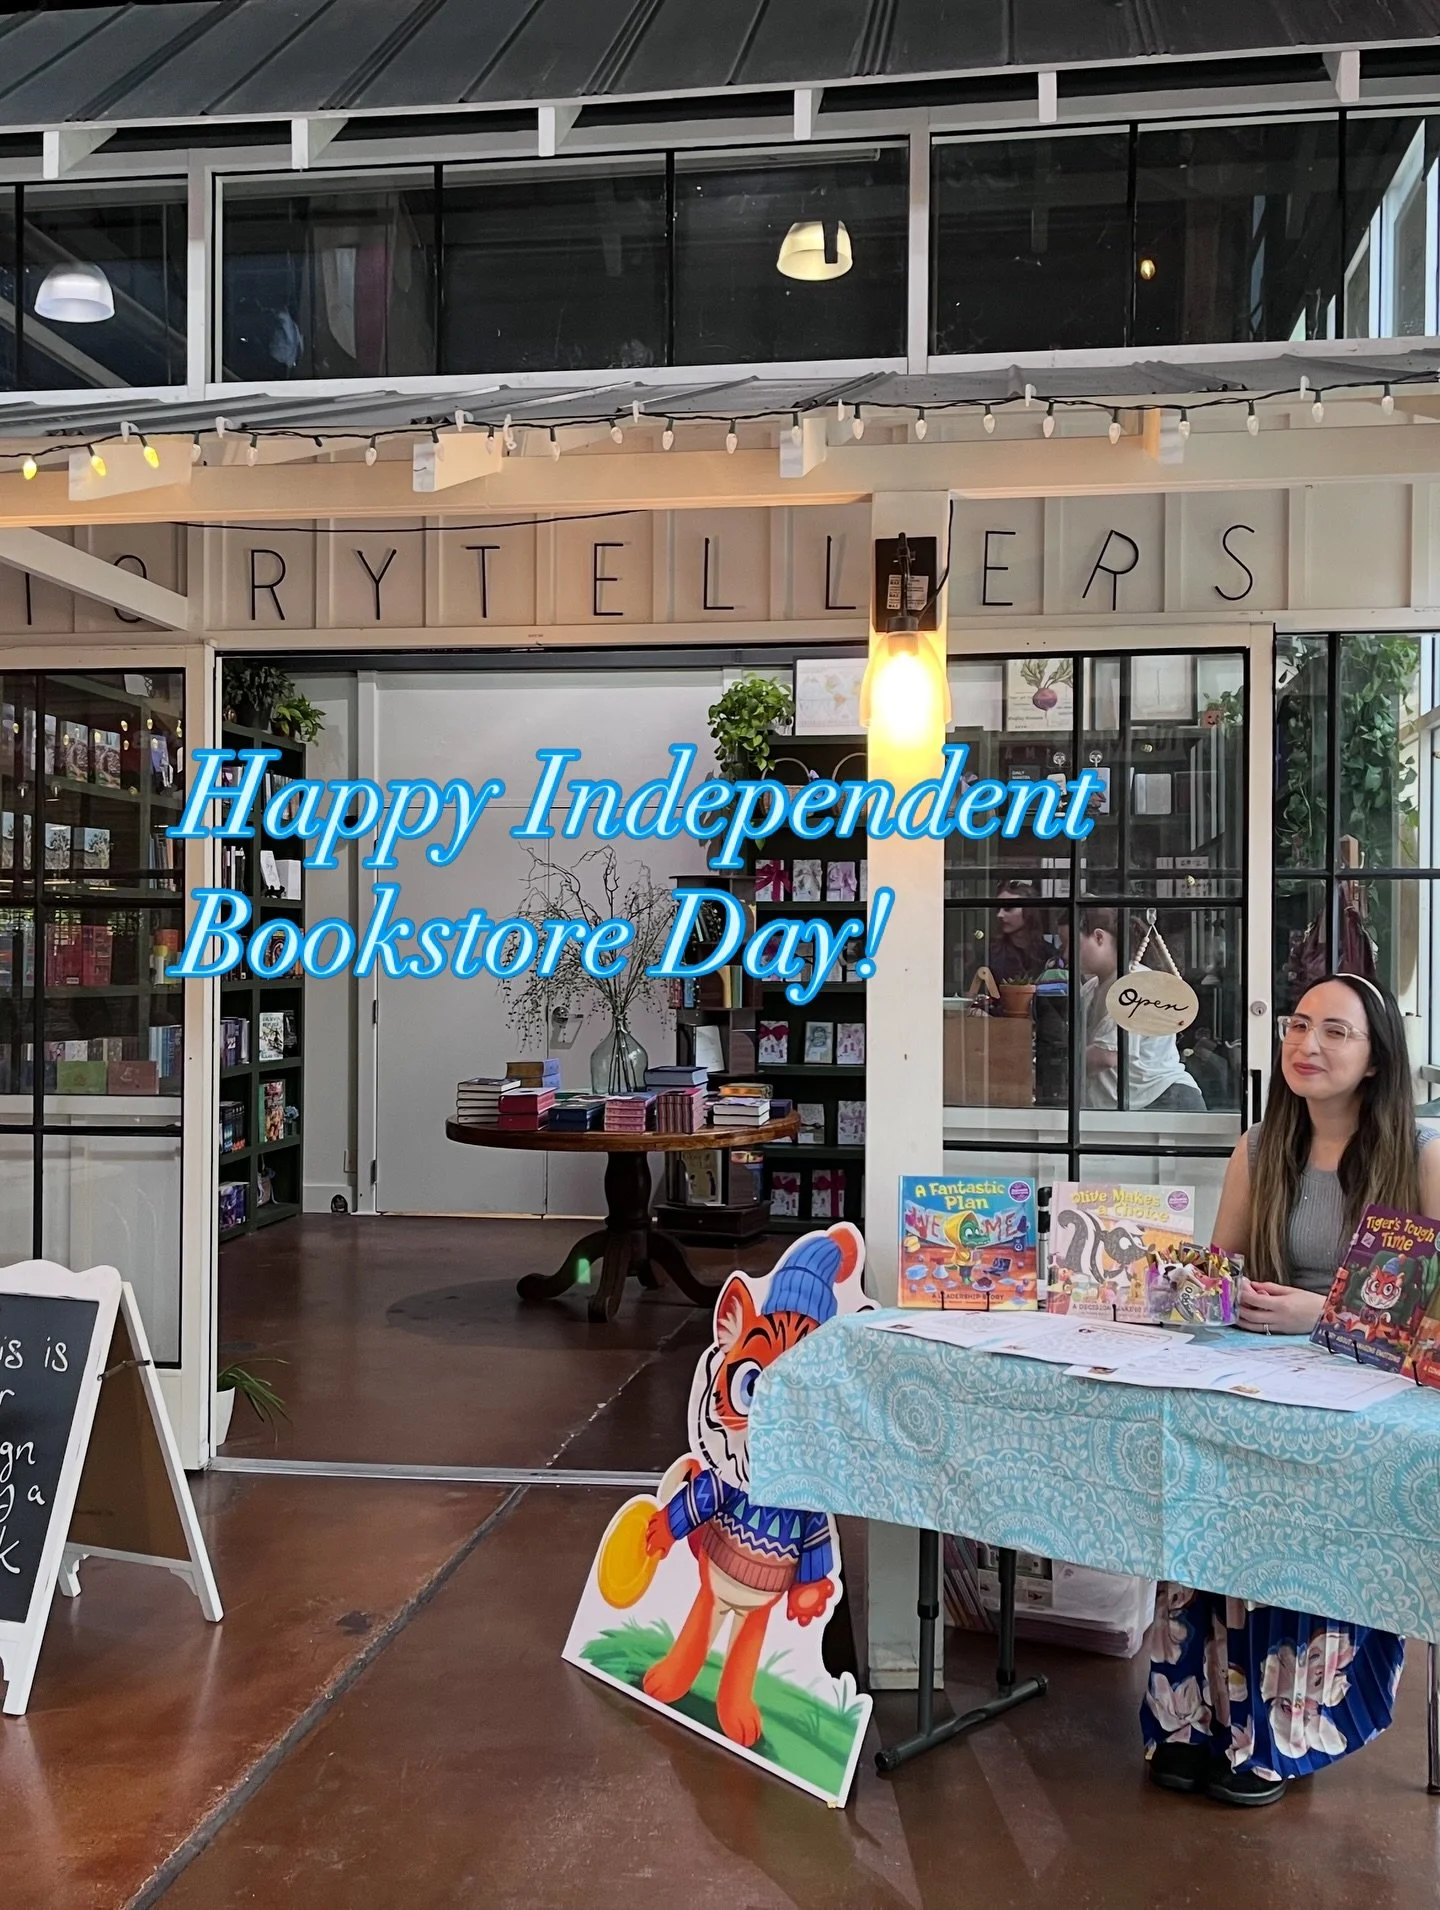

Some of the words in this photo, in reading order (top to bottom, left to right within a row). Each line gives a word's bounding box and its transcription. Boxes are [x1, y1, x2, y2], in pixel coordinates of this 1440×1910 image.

[1119, 988, 1189, 1018] Open
[915, 1184, 927, 1197] A
[929, 1180, 1005, 1196] Fantastic
[1112, 1188, 1161, 1207] Makes
[944, 1195, 989, 1210] Plan
[1097, 1205, 1108, 1217] a
[1114, 1202, 1170, 1223] Choice
[908, 1205, 1018, 1240] WEME
[1366, 1215, 1402, 1232] Tiger's
[1403, 1218, 1436, 1243] Tough
[1381, 1231, 1414, 1251] Time
[982, 1293, 1005, 1301] SORY
[45, 1336, 68, 1372] is
[28, 1485, 45, 1505] a
